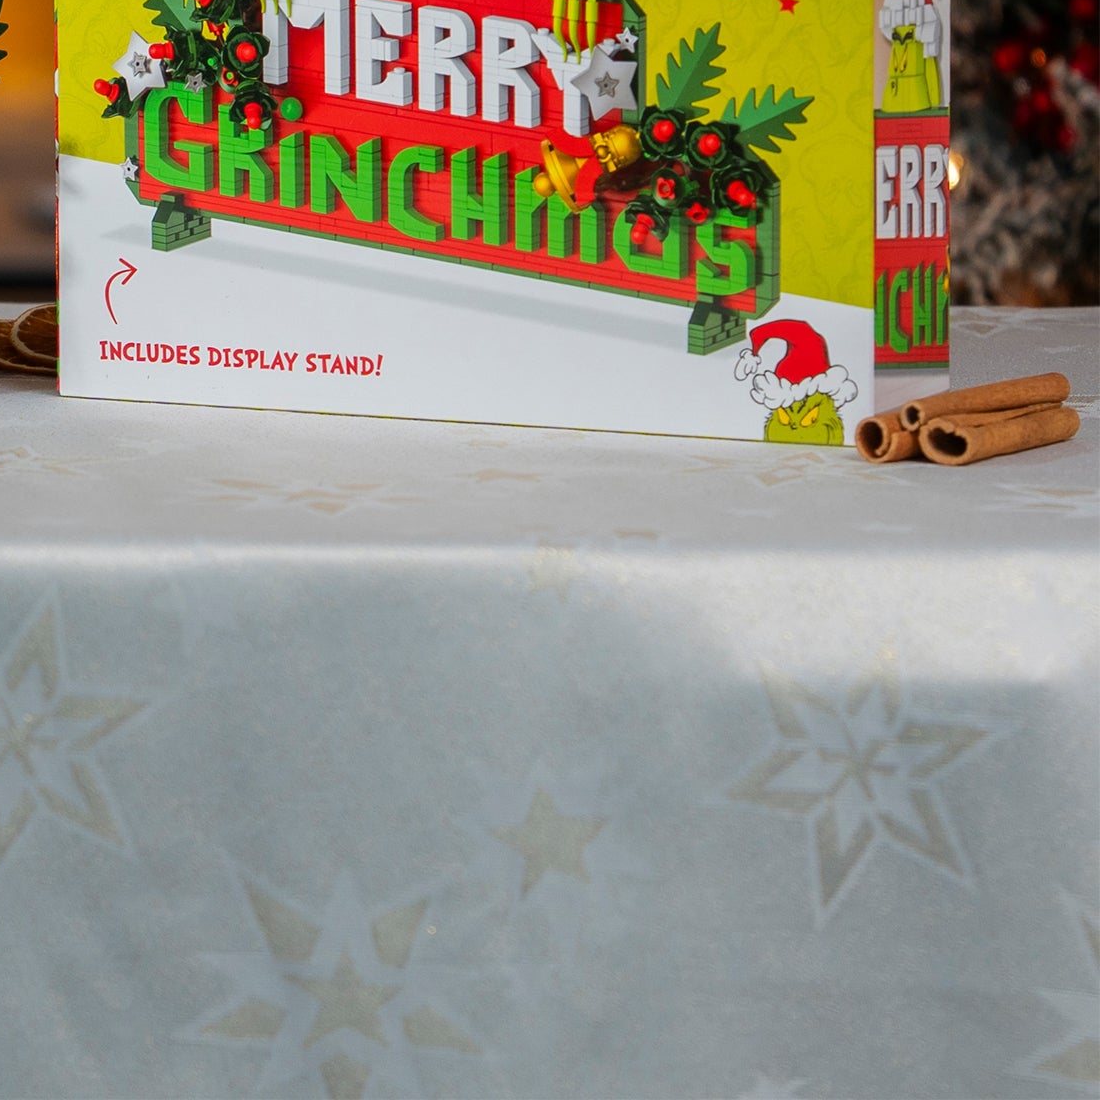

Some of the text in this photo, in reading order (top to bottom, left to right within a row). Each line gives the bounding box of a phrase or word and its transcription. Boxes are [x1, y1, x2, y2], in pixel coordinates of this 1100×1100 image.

[99, 340, 384, 377] INCLUDES DISPLAY STAND!
